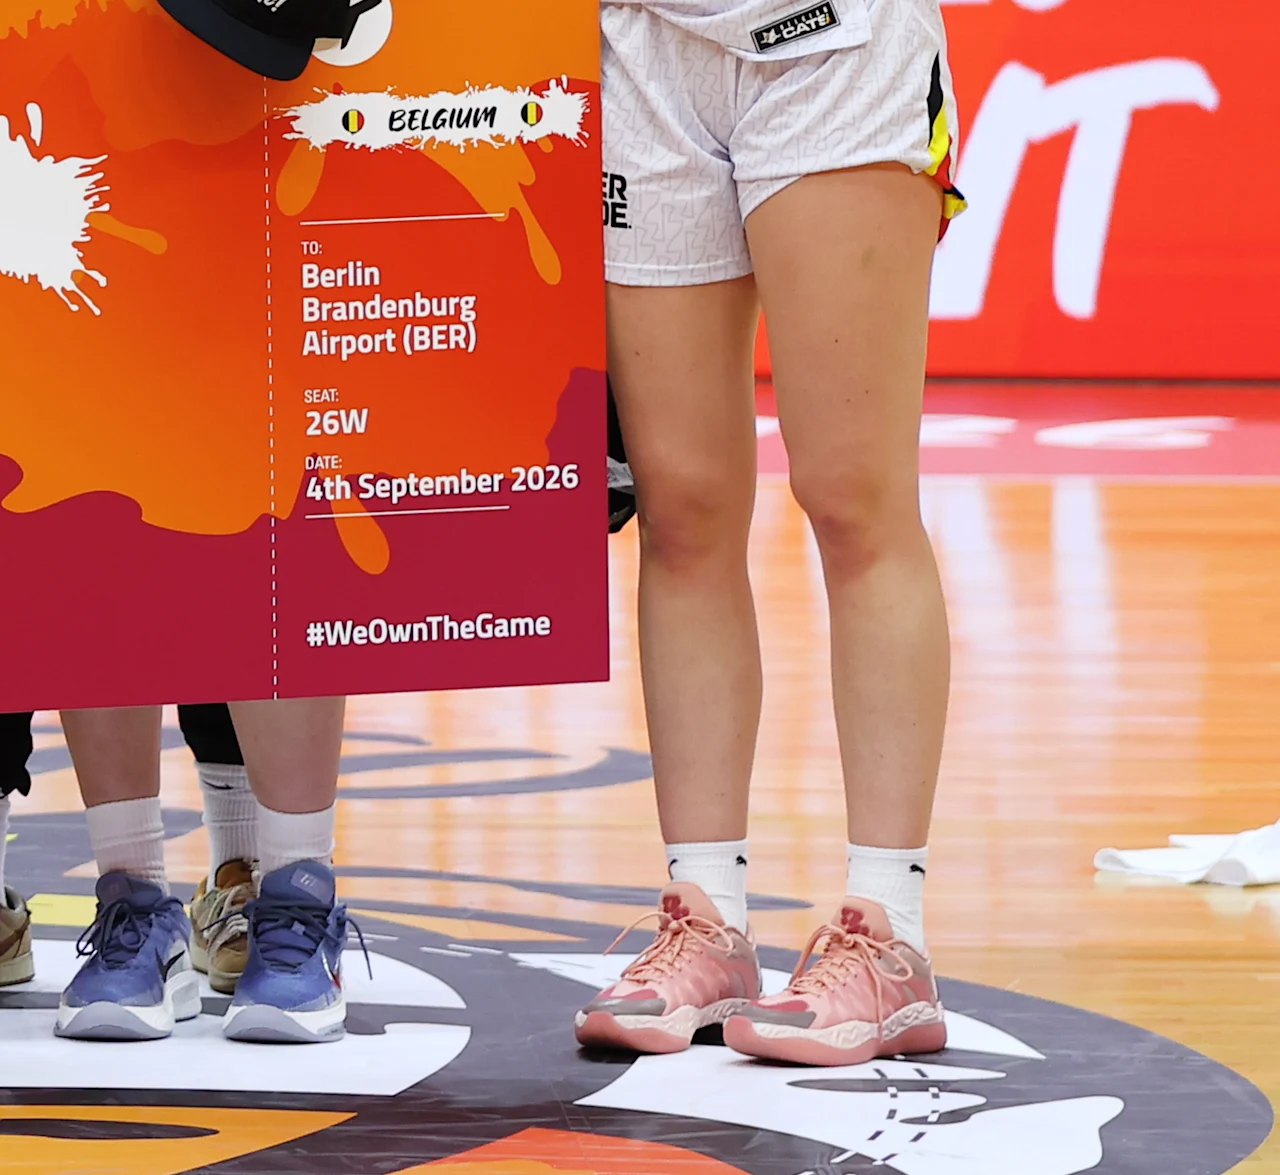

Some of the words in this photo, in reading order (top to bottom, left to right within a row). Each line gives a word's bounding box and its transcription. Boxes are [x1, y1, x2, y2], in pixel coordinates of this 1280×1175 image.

[388, 106, 498, 132] BELGIUM
[300, 240, 323, 256] TO:
[301, 261, 380, 289] Berlin
[302, 292, 477, 323] Brandenburg
[302, 328, 397, 362] Airport
[402, 321, 478, 356] (BER)
[303, 388, 340, 404] SEAT:
[305, 408, 369, 436] 26W
[304, 455, 343, 471] DATE:
[305, 476, 352, 501] 4th
[358, 468, 504, 505] September
[510, 464, 579, 492] 2026
[306, 613, 551, 647] #WeOwnTheGame
